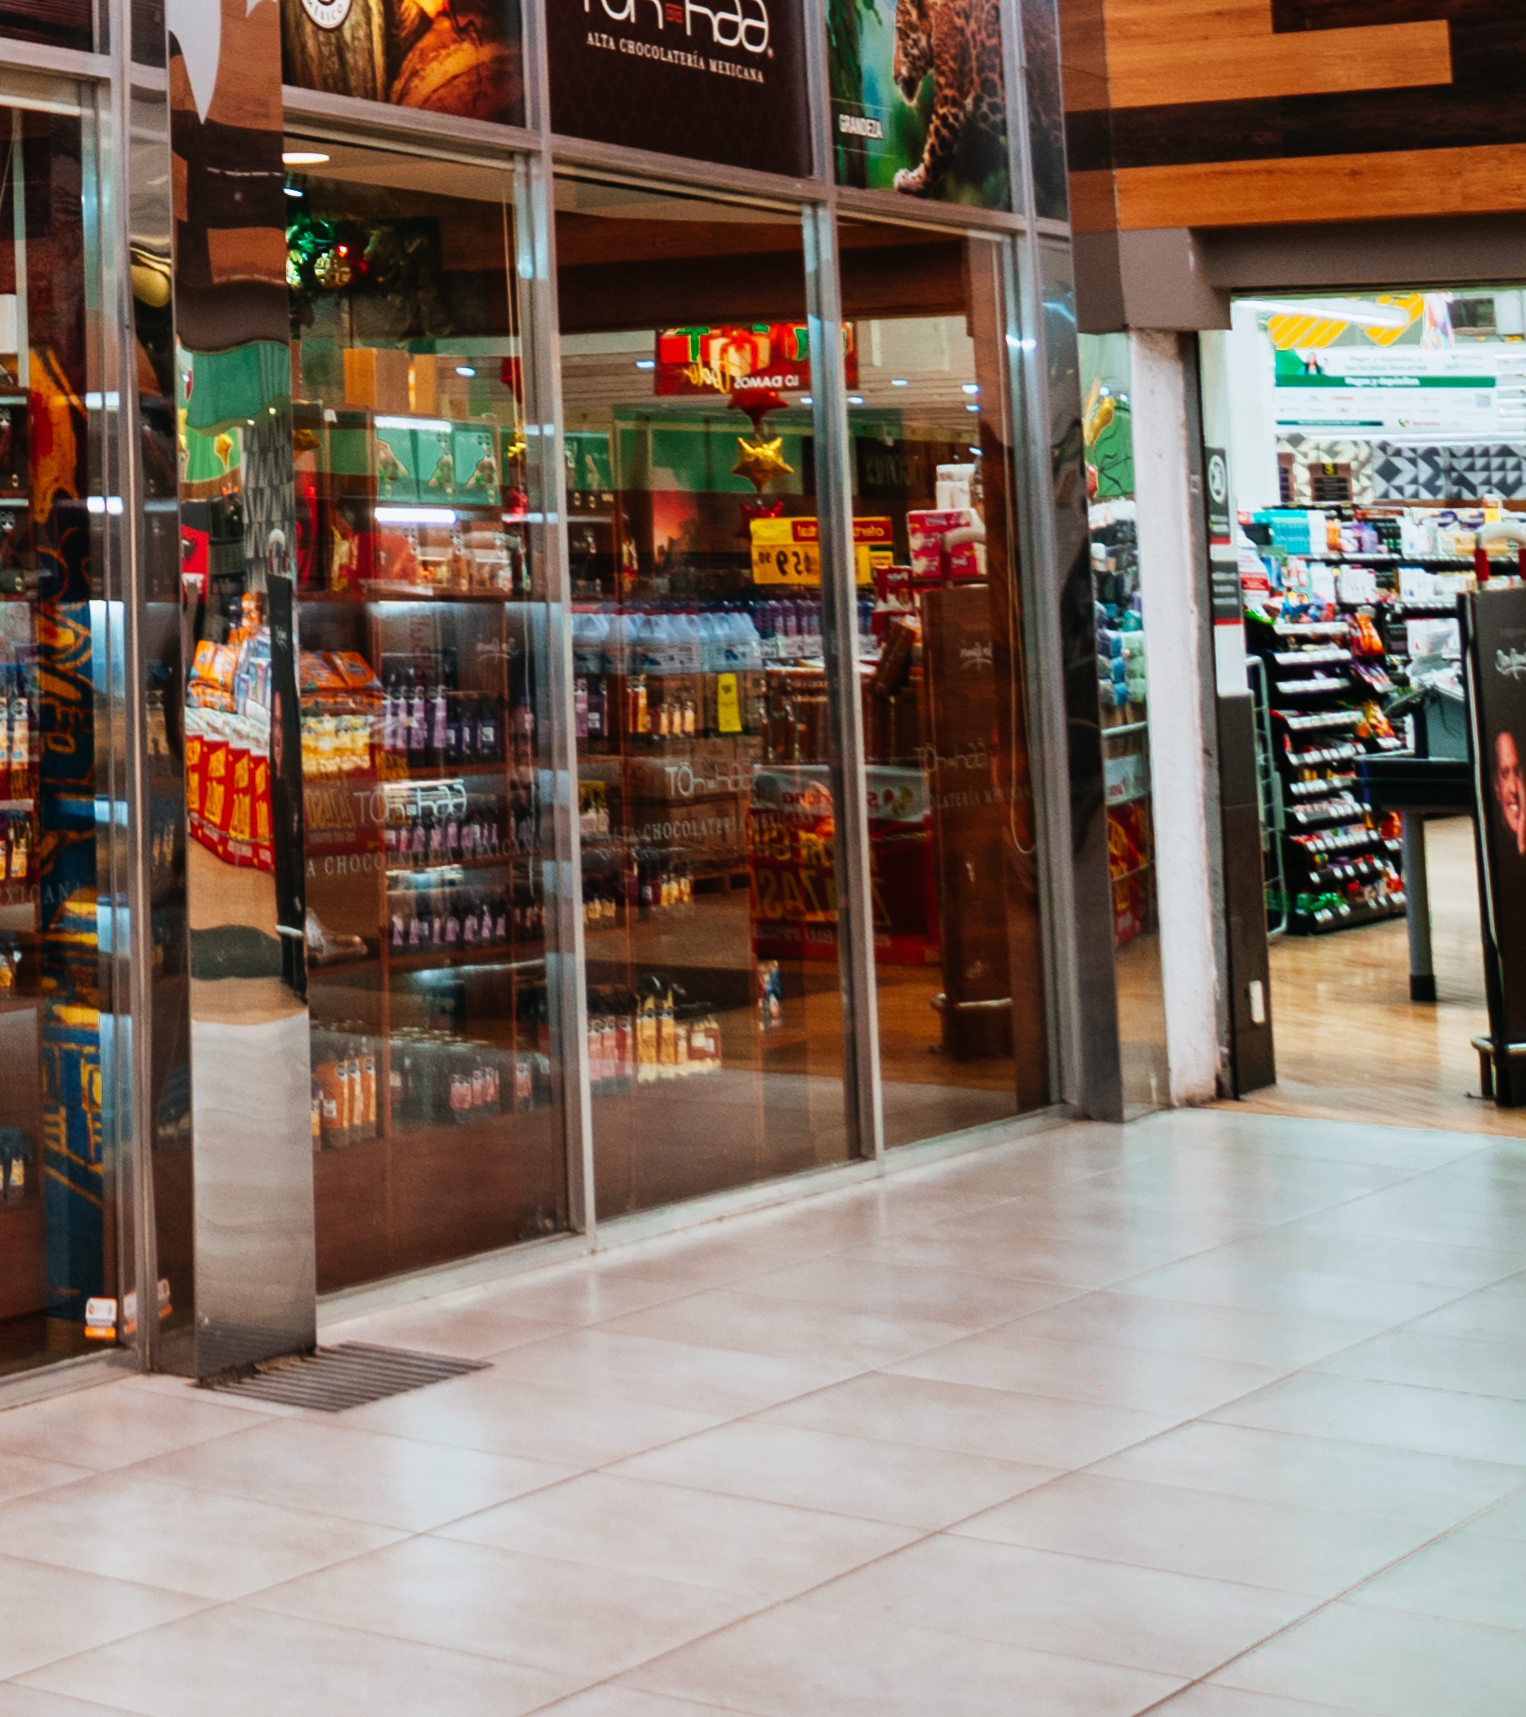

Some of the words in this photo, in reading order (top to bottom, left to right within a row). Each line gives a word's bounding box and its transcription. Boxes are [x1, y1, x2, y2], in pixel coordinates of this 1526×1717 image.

[586, 32, 616, 51] ALTA
[619, 38, 706, 70] CHOCOLATERÍA
[708, 58, 774, 83] MEXICANA
